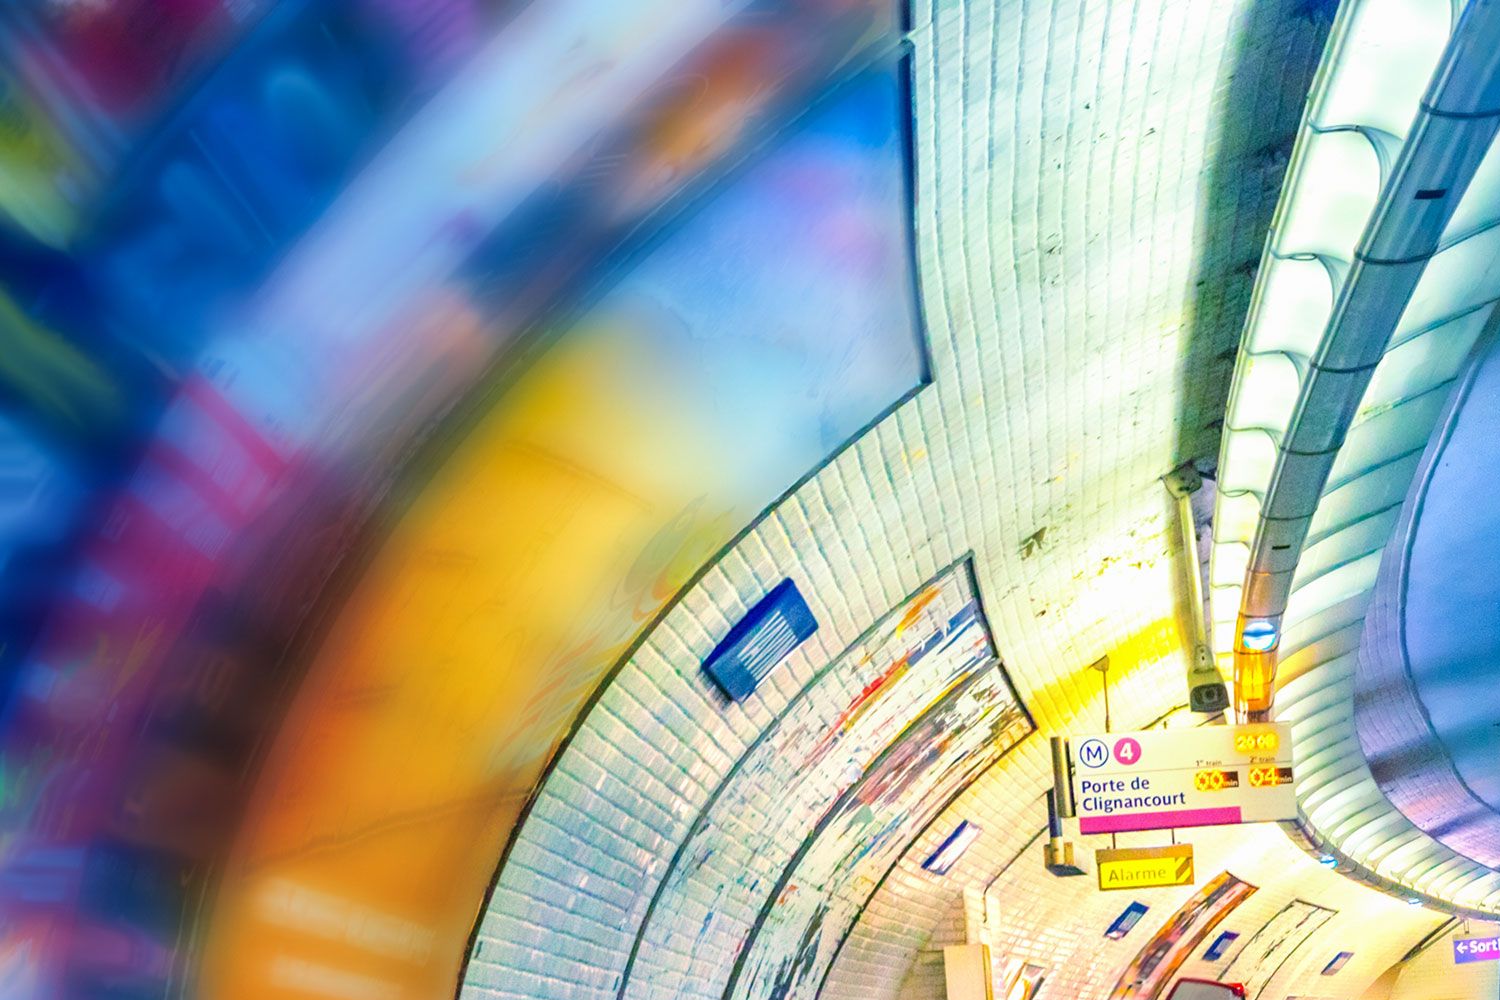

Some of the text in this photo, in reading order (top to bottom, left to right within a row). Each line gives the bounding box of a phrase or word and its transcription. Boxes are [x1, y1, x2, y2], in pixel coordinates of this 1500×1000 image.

[1086, 746, 1103, 761] M
[1120, 742, 1133, 760] 4
[1081, 776, 1150, 793] Porte de
[1250, 767, 1278, 786] 04
[1083, 792, 1186, 813] Clignancourt
[1108, 868, 1167, 882] Alarme
